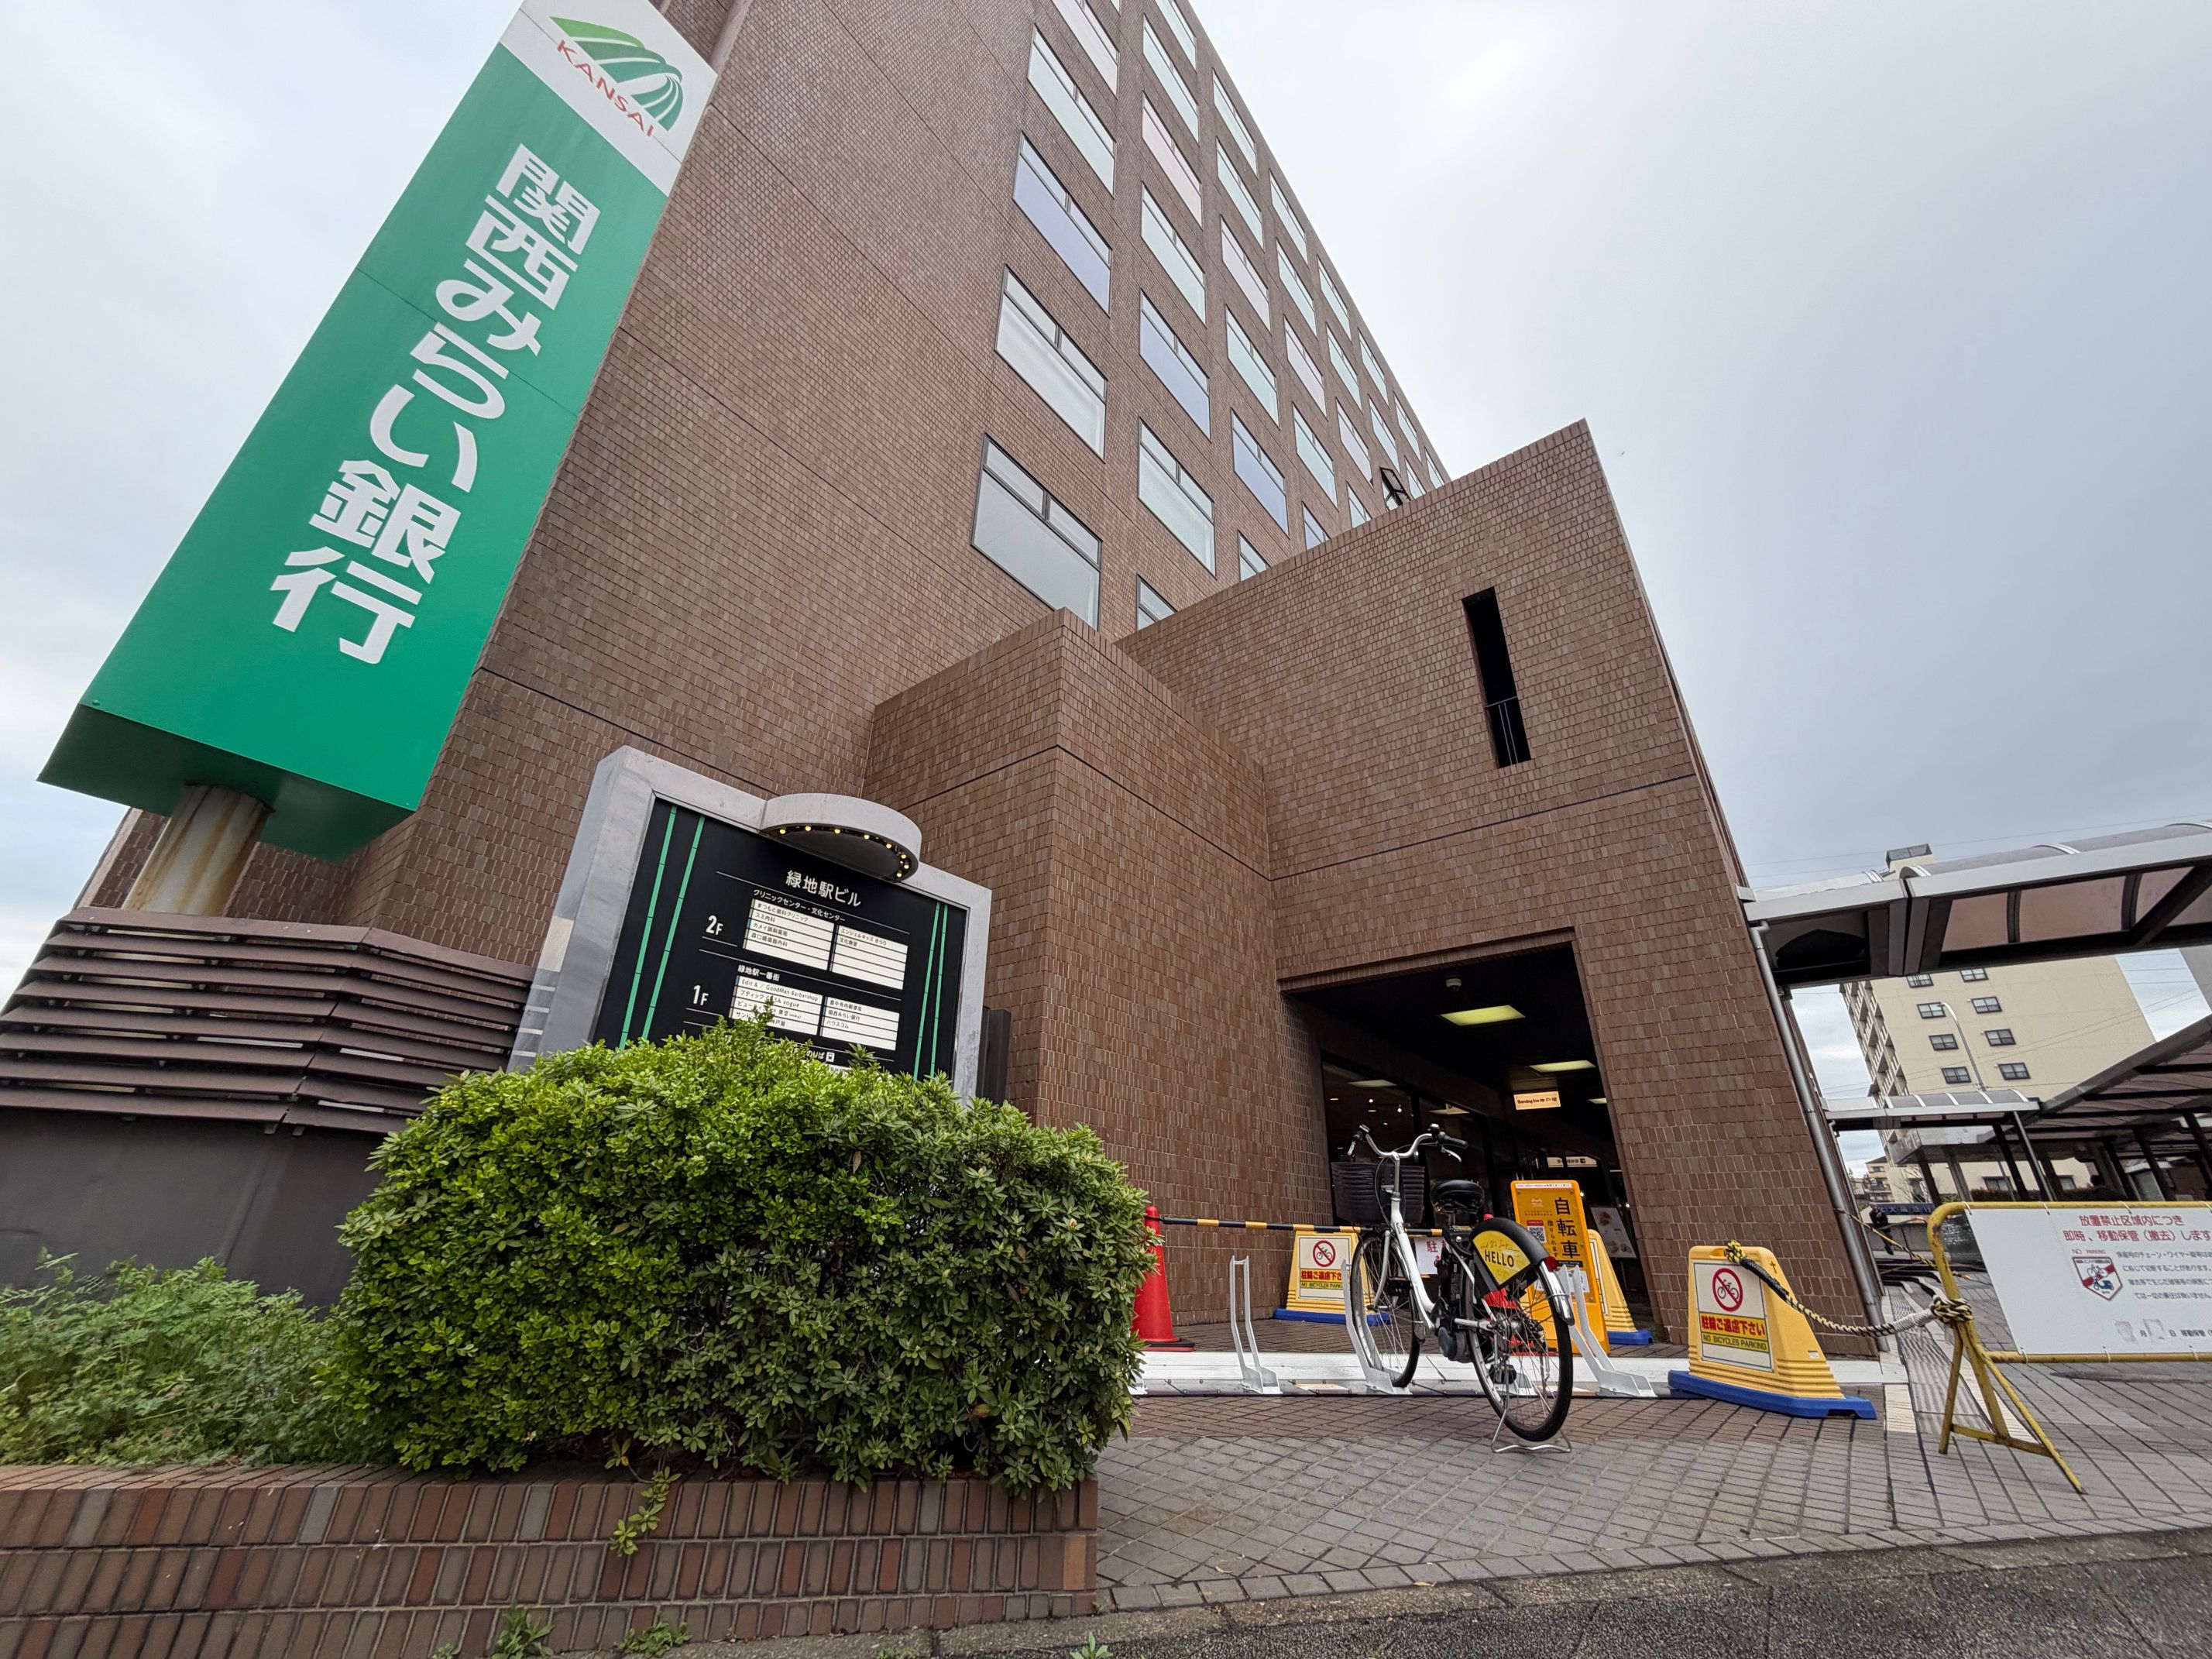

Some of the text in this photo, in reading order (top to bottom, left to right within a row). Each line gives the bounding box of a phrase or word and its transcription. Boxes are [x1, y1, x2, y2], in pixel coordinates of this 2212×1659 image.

[555, 40, 656, 138] KANSAI
[270, 143, 600, 665] 関西みらい銀行
[785, 870, 861, 908] 緑地駅ビル
[753, 889, 846, 922] クリニックセンター・文化センター
[706, 915, 724, 936] 2F
[692, 984, 709, 1006] 1F
[1554, 1197, 1581, 1259] 自転車
[2078, 1214, 2185, 1227] 放置禁止区域内につき
[1485, 1249, 1514, 1267] HELLO
[1301, 1270, 1342, 1281] 駐輪ご遠慮下さ
[1701, 1315, 1766, 1337] 駐輪ご遠慮下さい
[1703, 1334, 1767, 1351] NO BICYCLES PARKING
